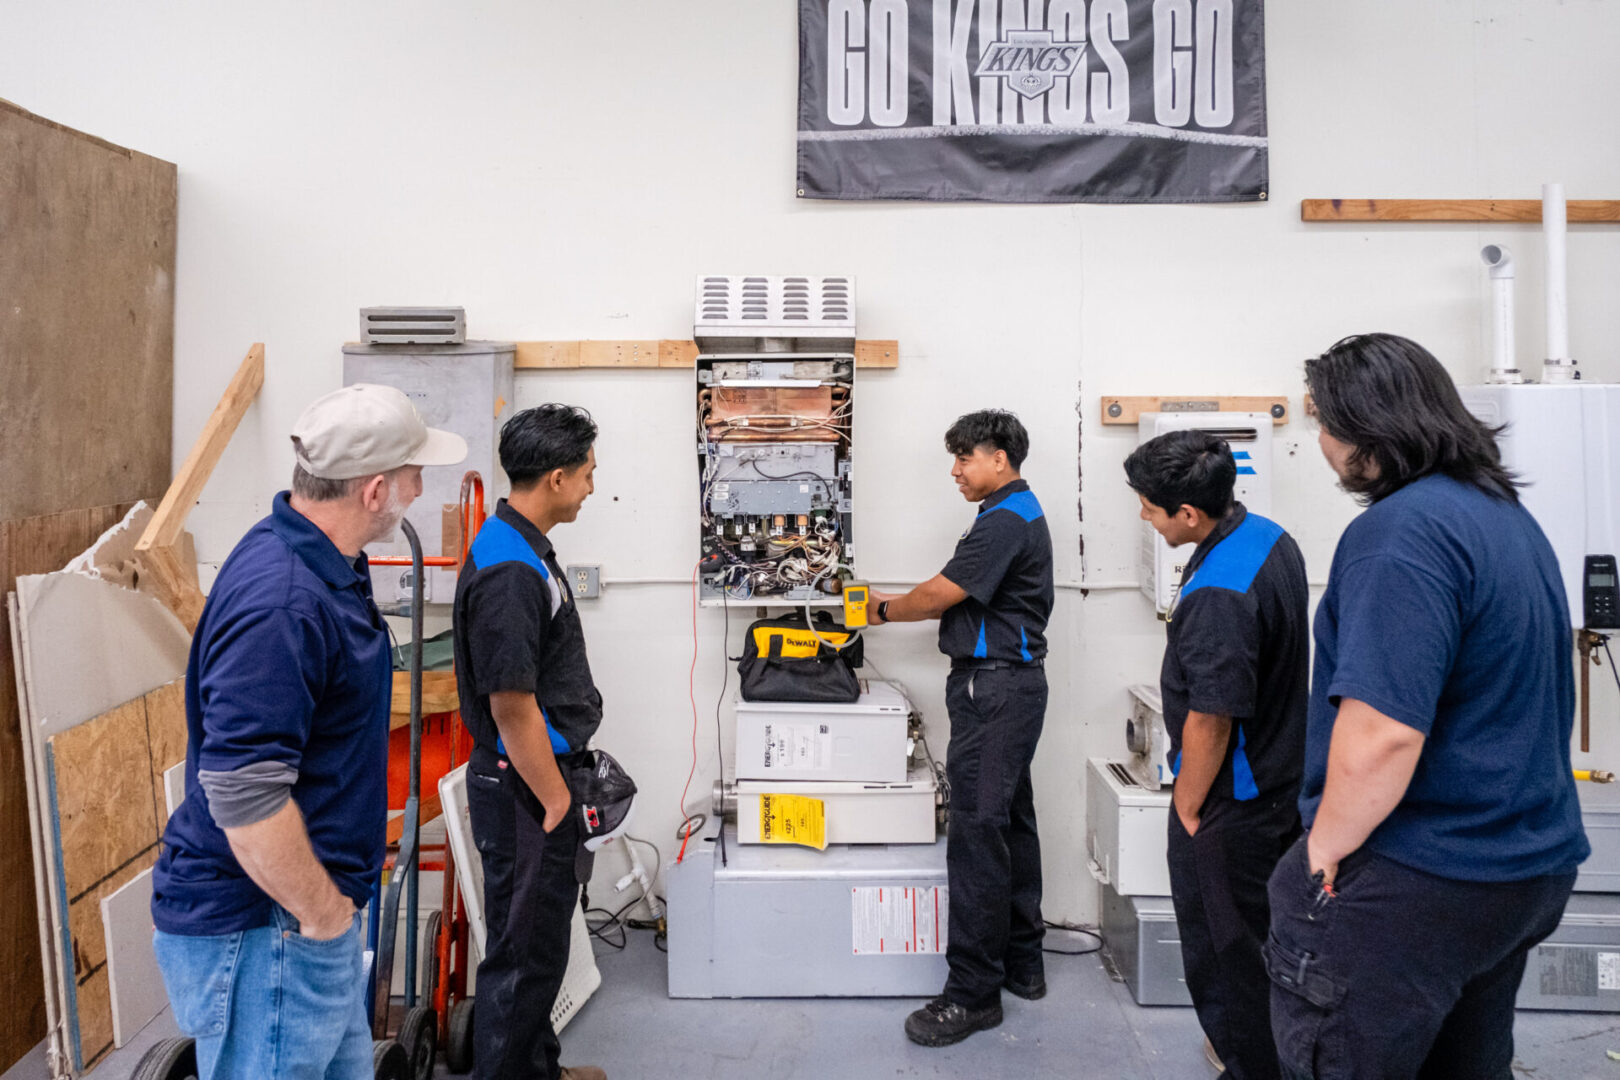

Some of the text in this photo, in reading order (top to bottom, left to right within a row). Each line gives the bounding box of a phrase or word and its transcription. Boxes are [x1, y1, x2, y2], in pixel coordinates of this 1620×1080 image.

[827, 0, 1234, 128] GO KINGS GO
[984, 47, 1079, 71] KINGS
